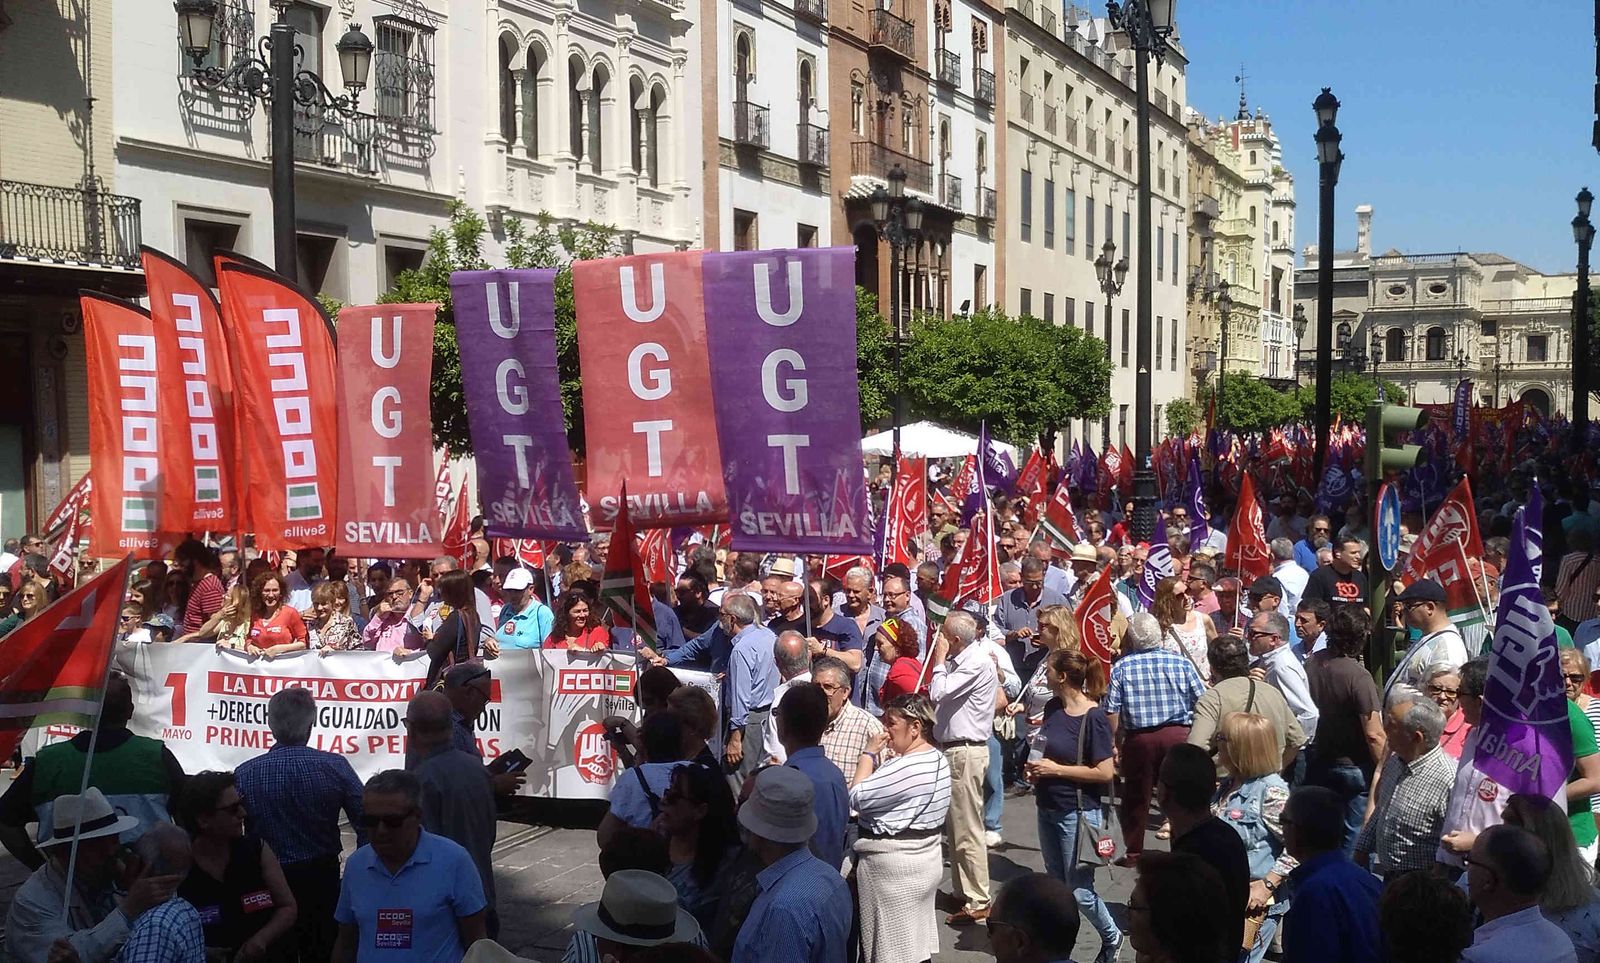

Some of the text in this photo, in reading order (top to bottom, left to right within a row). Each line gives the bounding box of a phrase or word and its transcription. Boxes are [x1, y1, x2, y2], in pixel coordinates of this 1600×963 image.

[619, 263, 673, 477] UGT
[753, 260, 810, 496] UGT
[485, 281, 533, 490] UGT
[371, 316, 403, 507] UGT
[344, 520, 433, 545] SEVILLA
[740, 510, 858, 539] SEVILLA
[222, 675, 248, 694] LA
[164, 672, 188, 727] 1
[206, 699, 270, 725] +DERECH
[605, 698, 635, 711] Sevilla
[162, 727, 192, 741] MAYO
[205, 725, 273, 750] PRIME
[316, 734, 360, 755] LAS
